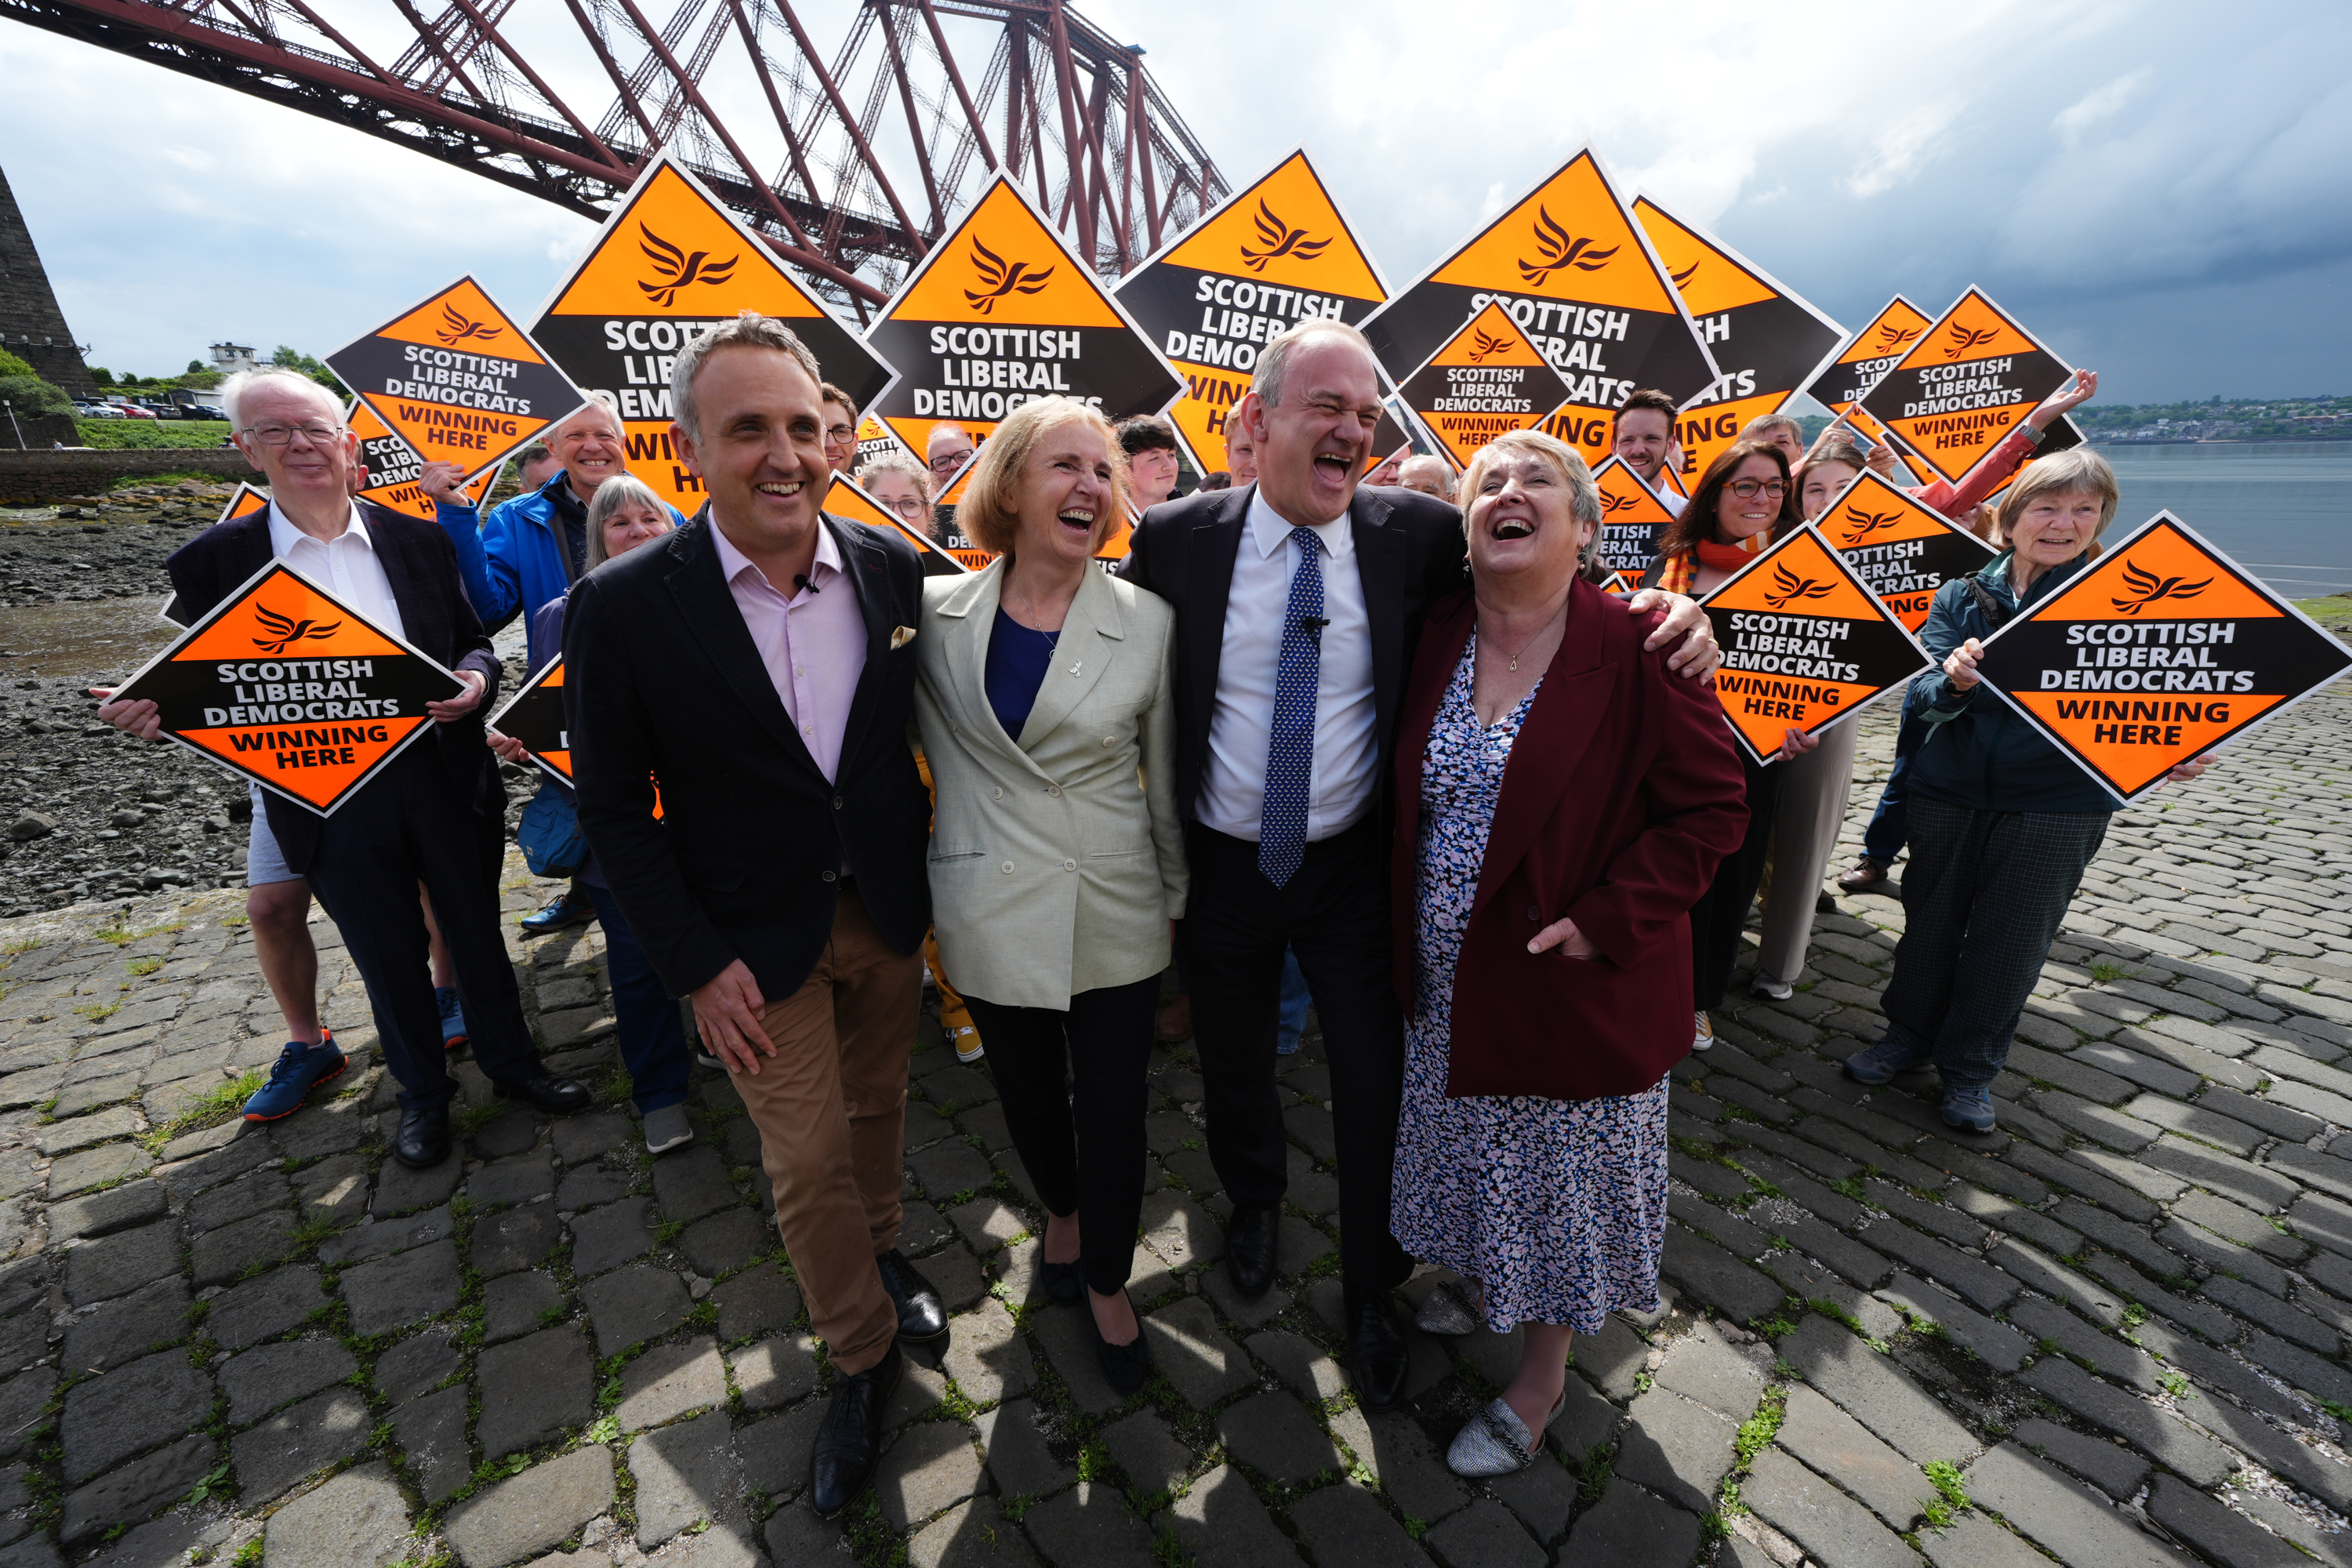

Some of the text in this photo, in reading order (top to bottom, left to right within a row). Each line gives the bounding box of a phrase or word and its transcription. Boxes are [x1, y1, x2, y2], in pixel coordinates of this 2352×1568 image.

[1196, 275, 1344, 322] SCOTTISH
[1201, 307, 1298, 344] LIBER
[931, 326, 1080, 359] SCOTTISH
[405, 345, 517, 379] SCOTTISH
[943, 358, 1070, 390] LIBERAL
[1918, 357, 2013, 383] SCOTTISH
[412, 364, 508, 394] LIBERAL
[1446, 368, 1525, 383] SCOTTISH
[1924, 376, 2003, 399] LIBERAL
[386, 378, 531, 415] DEMOCRATS
[1451, 383, 1516, 397] LIBERAL
[1904, 388, 2023, 418] DEMOCRATS
[1433, 397, 1532, 412] DEMOCRATS
[398, 404, 517, 437] WINNING
[1441, 417, 1520, 431] WINNING
[1914, 411, 2009, 437] WINNING
[427, 427, 488, 451] HERE
[1936, 430, 1985, 449] HERE
[1841, 540, 1924, 566] OTTISH
[1730, 612, 1850, 641] SCOTTISH
[2066, 622, 2236, 645] SCOTTISH
[1736, 632, 1835, 659] LIBERAL
[2076, 647, 2218, 667] LIBERAL
[217, 659, 373, 683] SCOTTISH
[2040, 670, 2256, 692] DEMOCRATS
[234, 681, 367, 703] LIBERAL
[1719, 674, 1840, 706] WINNING
[203, 699, 400, 726] DEMOCRATS
[1744, 697, 1806, 720] HERE
[2056, 699, 2230, 724] WINNING
[228, 725, 388, 752] WINNING
[2094, 724, 2183, 746] HERE
[276, 747, 355, 769] HERE
